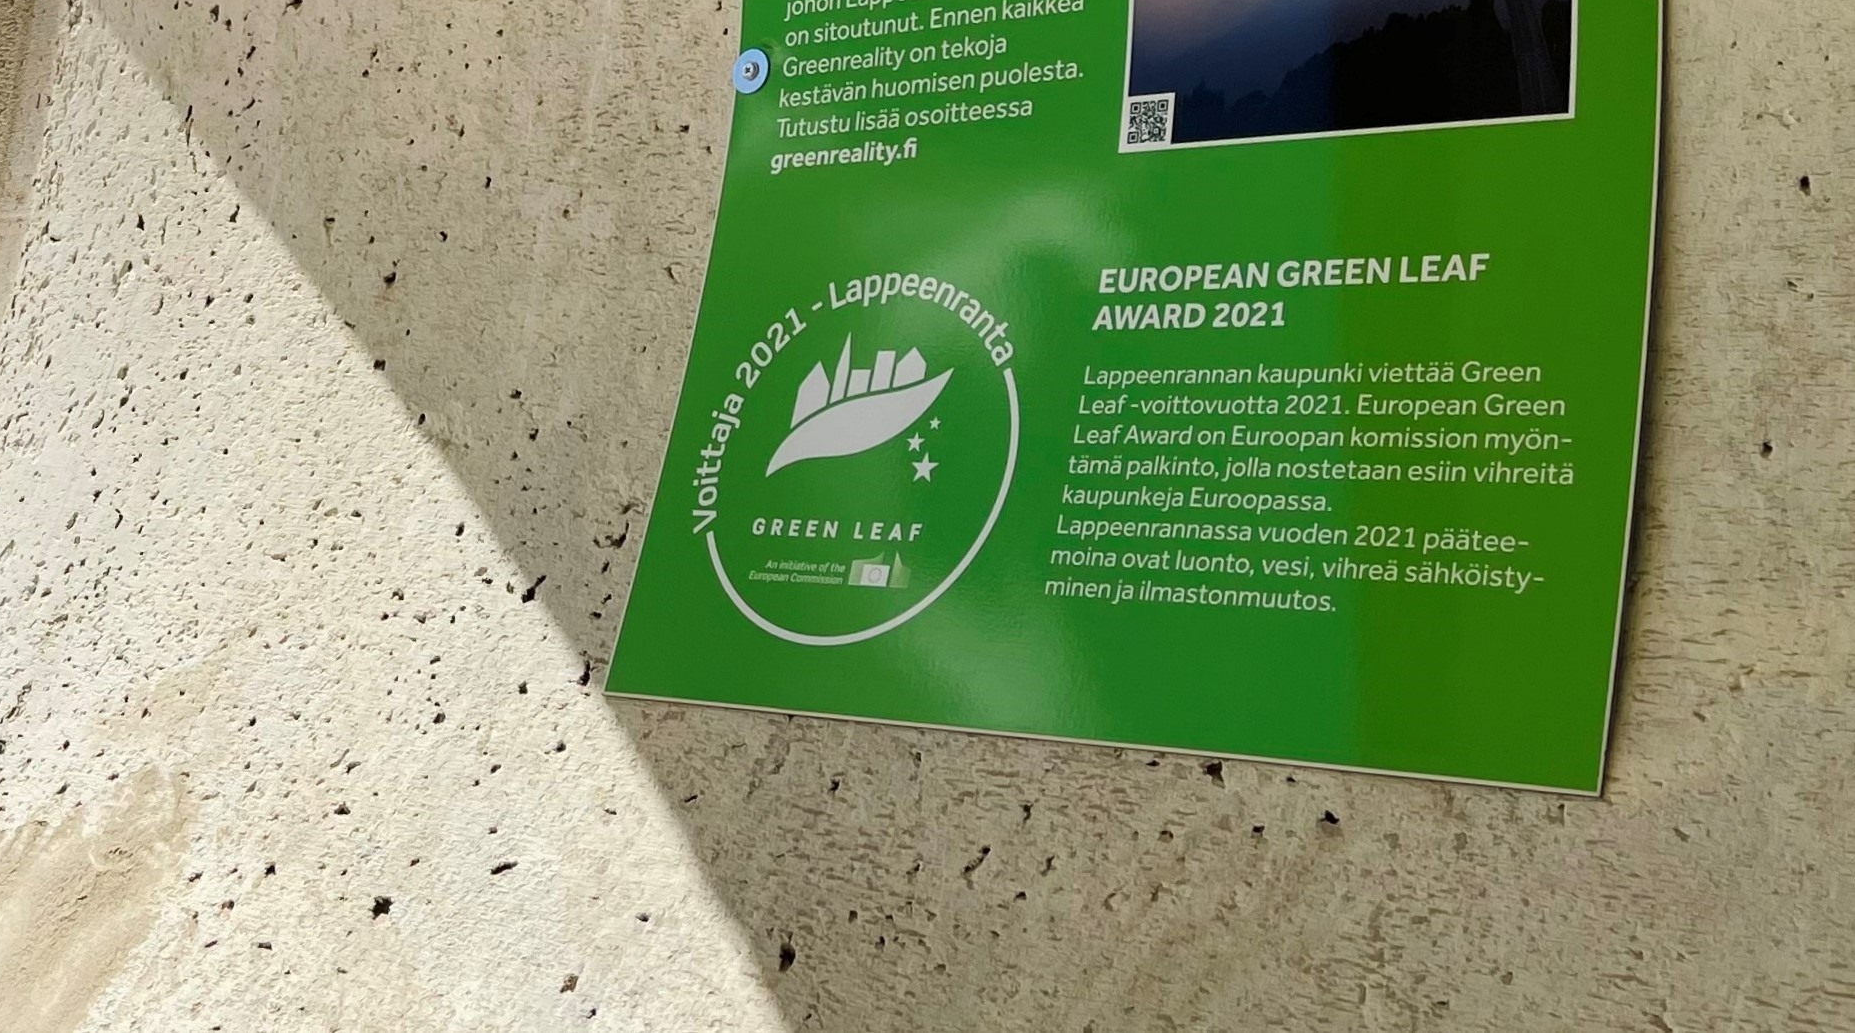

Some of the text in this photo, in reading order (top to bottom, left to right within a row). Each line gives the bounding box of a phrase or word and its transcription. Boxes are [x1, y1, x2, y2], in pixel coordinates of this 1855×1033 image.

[785, 28, 809, 46] on
[814, 11, 924, 42] sitoutunut.
[930, 2, 996, 29] Ennen
[783, 35, 1007, 78] Greenreality on tekoja
[779, 59, 1083, 108] kestävän huomisen puolesta.
[777, 98, 1033, 138] Tutustu lisää osoitteessa
[770, 138, 917, 174] greenreality.fi
[1098, 253, 1490, 294] EUROPEAN GREEN LEAF
[1092, 301, 1286, 331] AWARD 2021
[1084, 361, 1542, 389] Lappeenrannan kaupunki viettää Green
[692, 394, 744, 534] Voittaja
[736, 307, 807, 389] 2021
[829, 272, 1014, 367] Lappeenranta
[1079, 394, 1566, 421] Leaf -voittovuotta 2021. European Green
[1074, 425, 1572, 455] Leaf Award on Euroopan komission myön-
[1068, 455, 1574, 486] tämä palkinto, jolla nostetaan esiin vihreitä
[1062, 485, 1332, 516] kaupunkeja Euroopassa.
[752, 517, 923, 541] GREEN LEAF
[1056, 515, 1529, 554] Lappeenrannassa vuoden 2021 päätee-
[749, 571, 843, 585] European Commission
[765, 559, 845, 573] An initiative of the
[1050, 547, 1544, 594] moina ovat luonto, vesi, vihreä sähköisty-
[1045, 578, 1337, 612] minen ja ilmastonmuutos.
